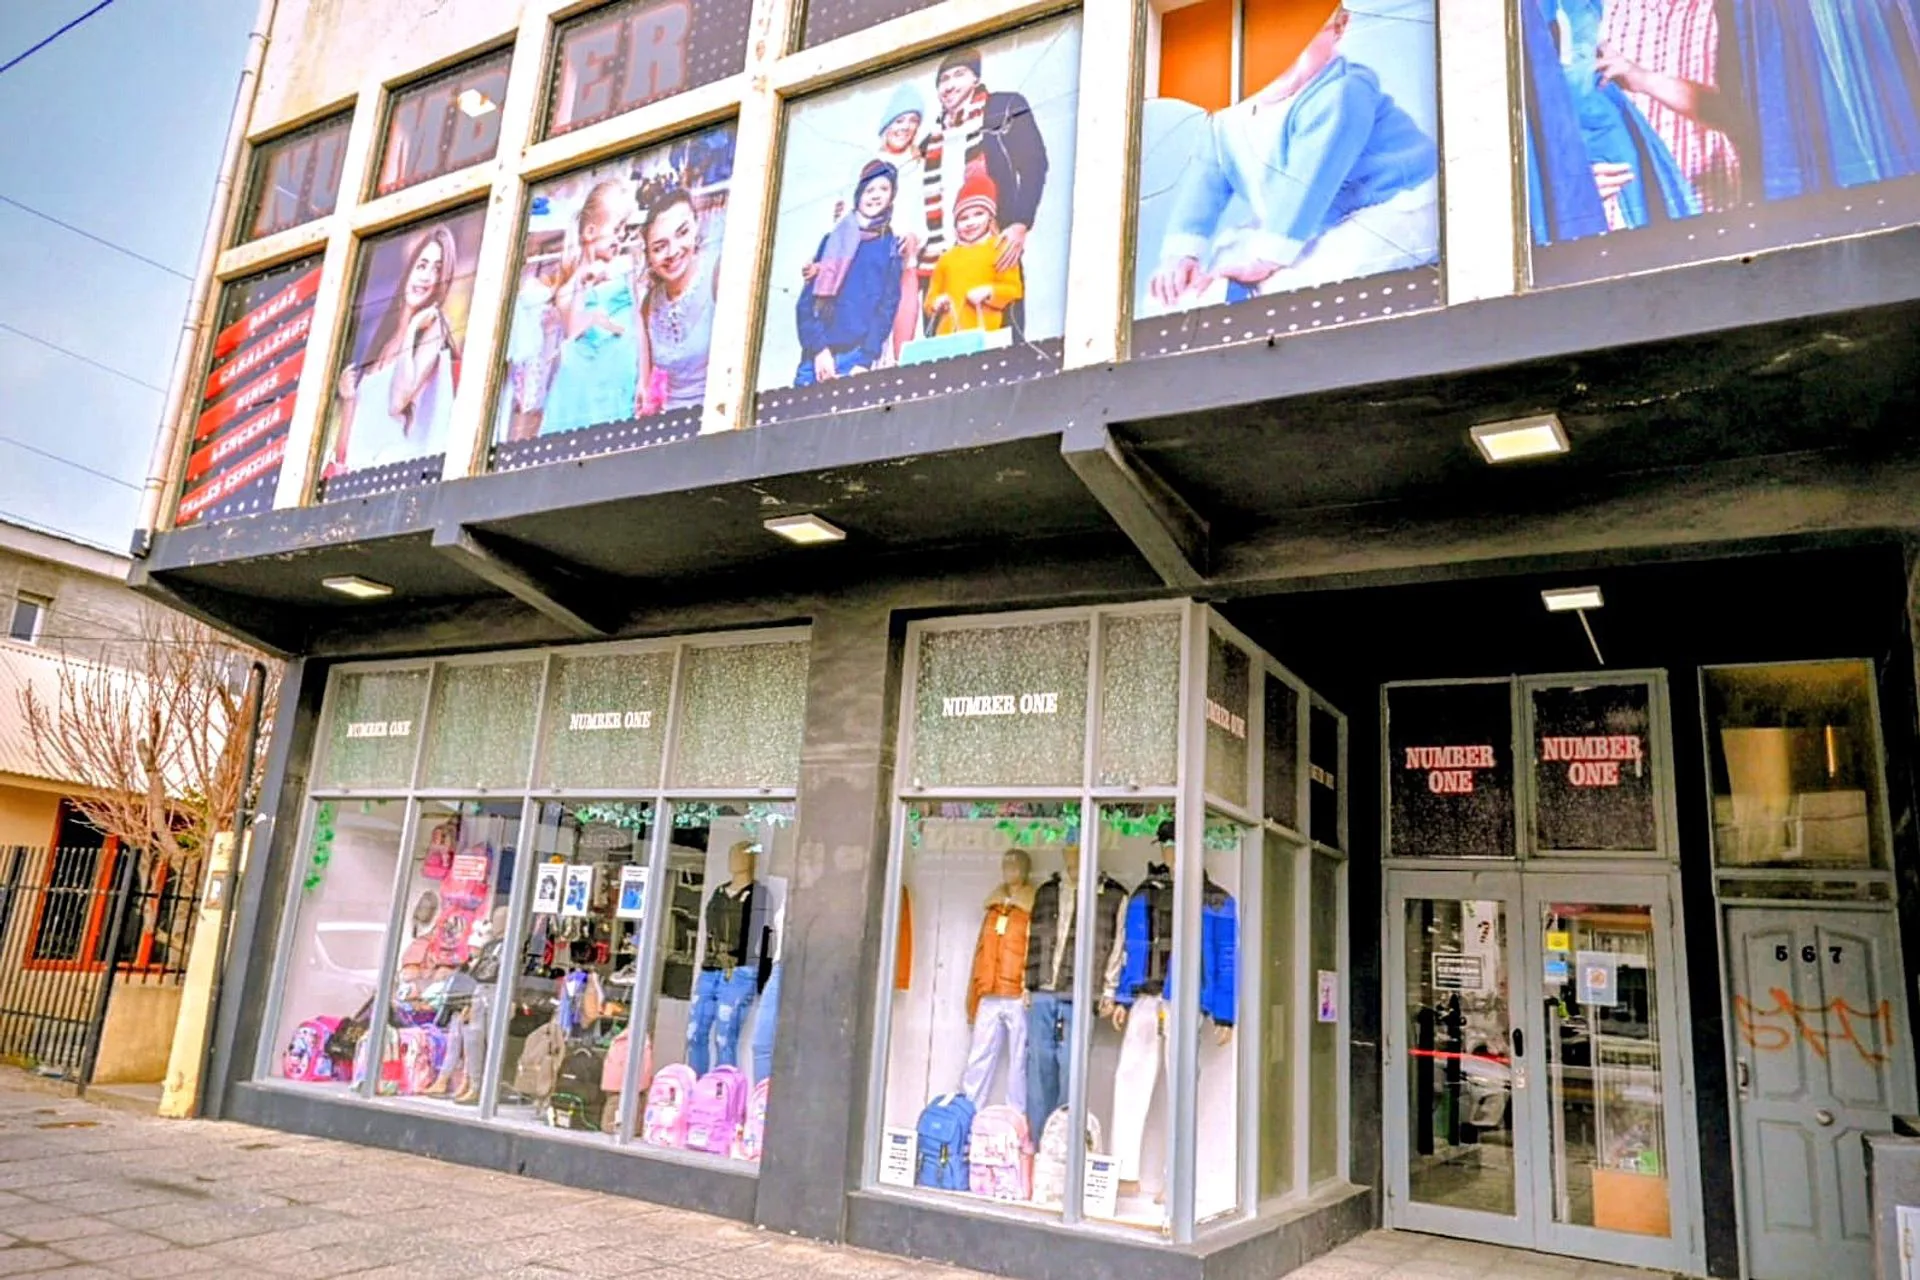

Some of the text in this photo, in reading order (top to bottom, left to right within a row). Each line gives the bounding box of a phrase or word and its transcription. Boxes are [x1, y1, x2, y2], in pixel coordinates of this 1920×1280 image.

[942, 693, 1058, 716] NUMBER ONE
[569, 711, 652, 730] NUMBER ONE
[1405, 745, 1496, 769] NUMBER
[1542, 736, 1642, 760] NUMBER
[1428, 770, 1473, 793] ONE
[1568, 762, 1620, 786] ONE
